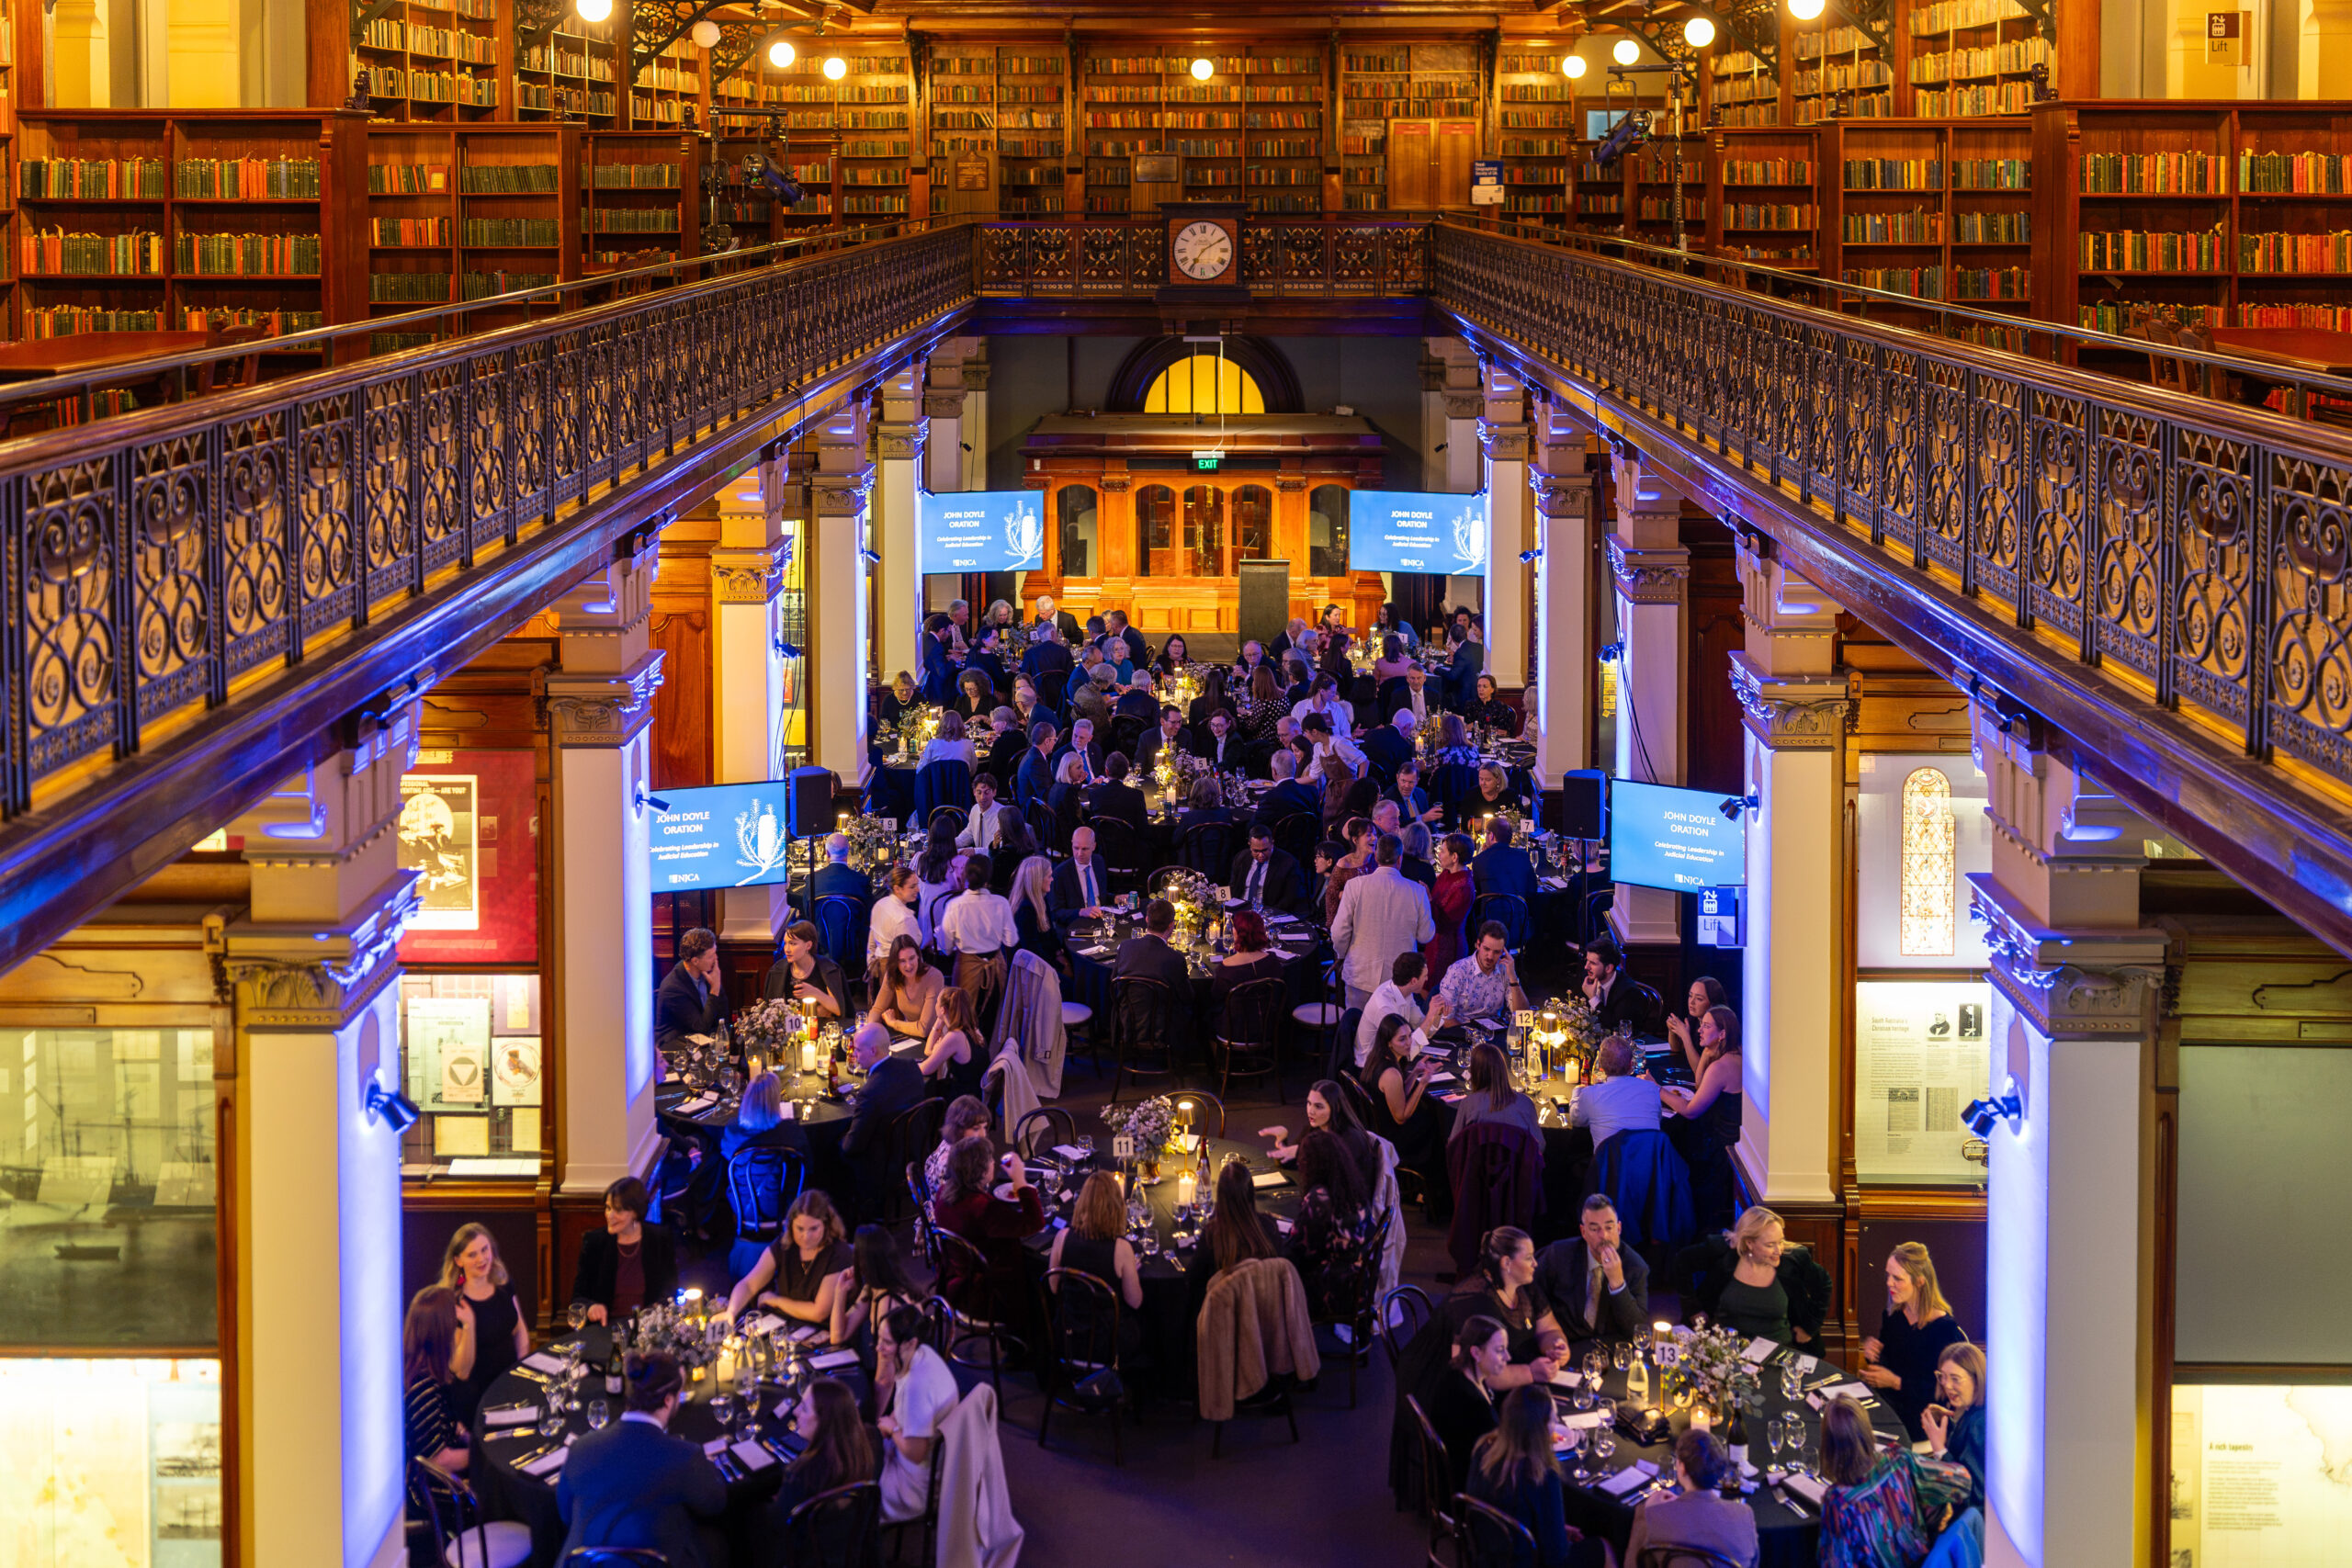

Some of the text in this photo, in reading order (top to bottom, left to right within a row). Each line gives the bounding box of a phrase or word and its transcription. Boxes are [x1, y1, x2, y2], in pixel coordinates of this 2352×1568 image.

[2211, 40, 2228, 52] Lift
[1198, 459, 1218, 469] EXIT
[944, 511, 963, 519] JOHN
[1390, 510, 1433, 519] JOHN DOYLE
[949, 520, 980, 528] ORATION
[1396, 520, 1428, 528] ORATION
[959, 558, 977, 567] NJCA
[1407, 558, 1425, 568] NJCA
[400, 786, 423, 795] VENTING
[656, 811, 710, 824] JOHN DOYLE
[1663, 810, 1716, 826] JOHN DOYLE
[663, 824, 703, 835] ORATION
[888, 819, 893, 829] 9
[1524, 821, 1530, 830] 7
[1670, 824, 1709, 837] ORATION
[681, 842, 712, 852] Leadership
[1654, 840, 1687, 852] Celebrating
[1687, 845, 1718, 856] Leadership
[680, 851, 709, 860] Education
[1664, 851, 1714, 863] Judicial Education
[677, 873, 700, 884] NJCA
[1682, 874, 1705, 886] NJCA
[1220, 889, 1227, 899] 8
[1703, 919, 1722, 931] Lift
[1520, 1012, 1531, 1024] 12
[788, 1018, 801, 1030] 10
[1116, 1140, 1129, 1153] 11
[711, 1322, 726, 1339] 14
[1659, 1347, 1676, 1363] 13
